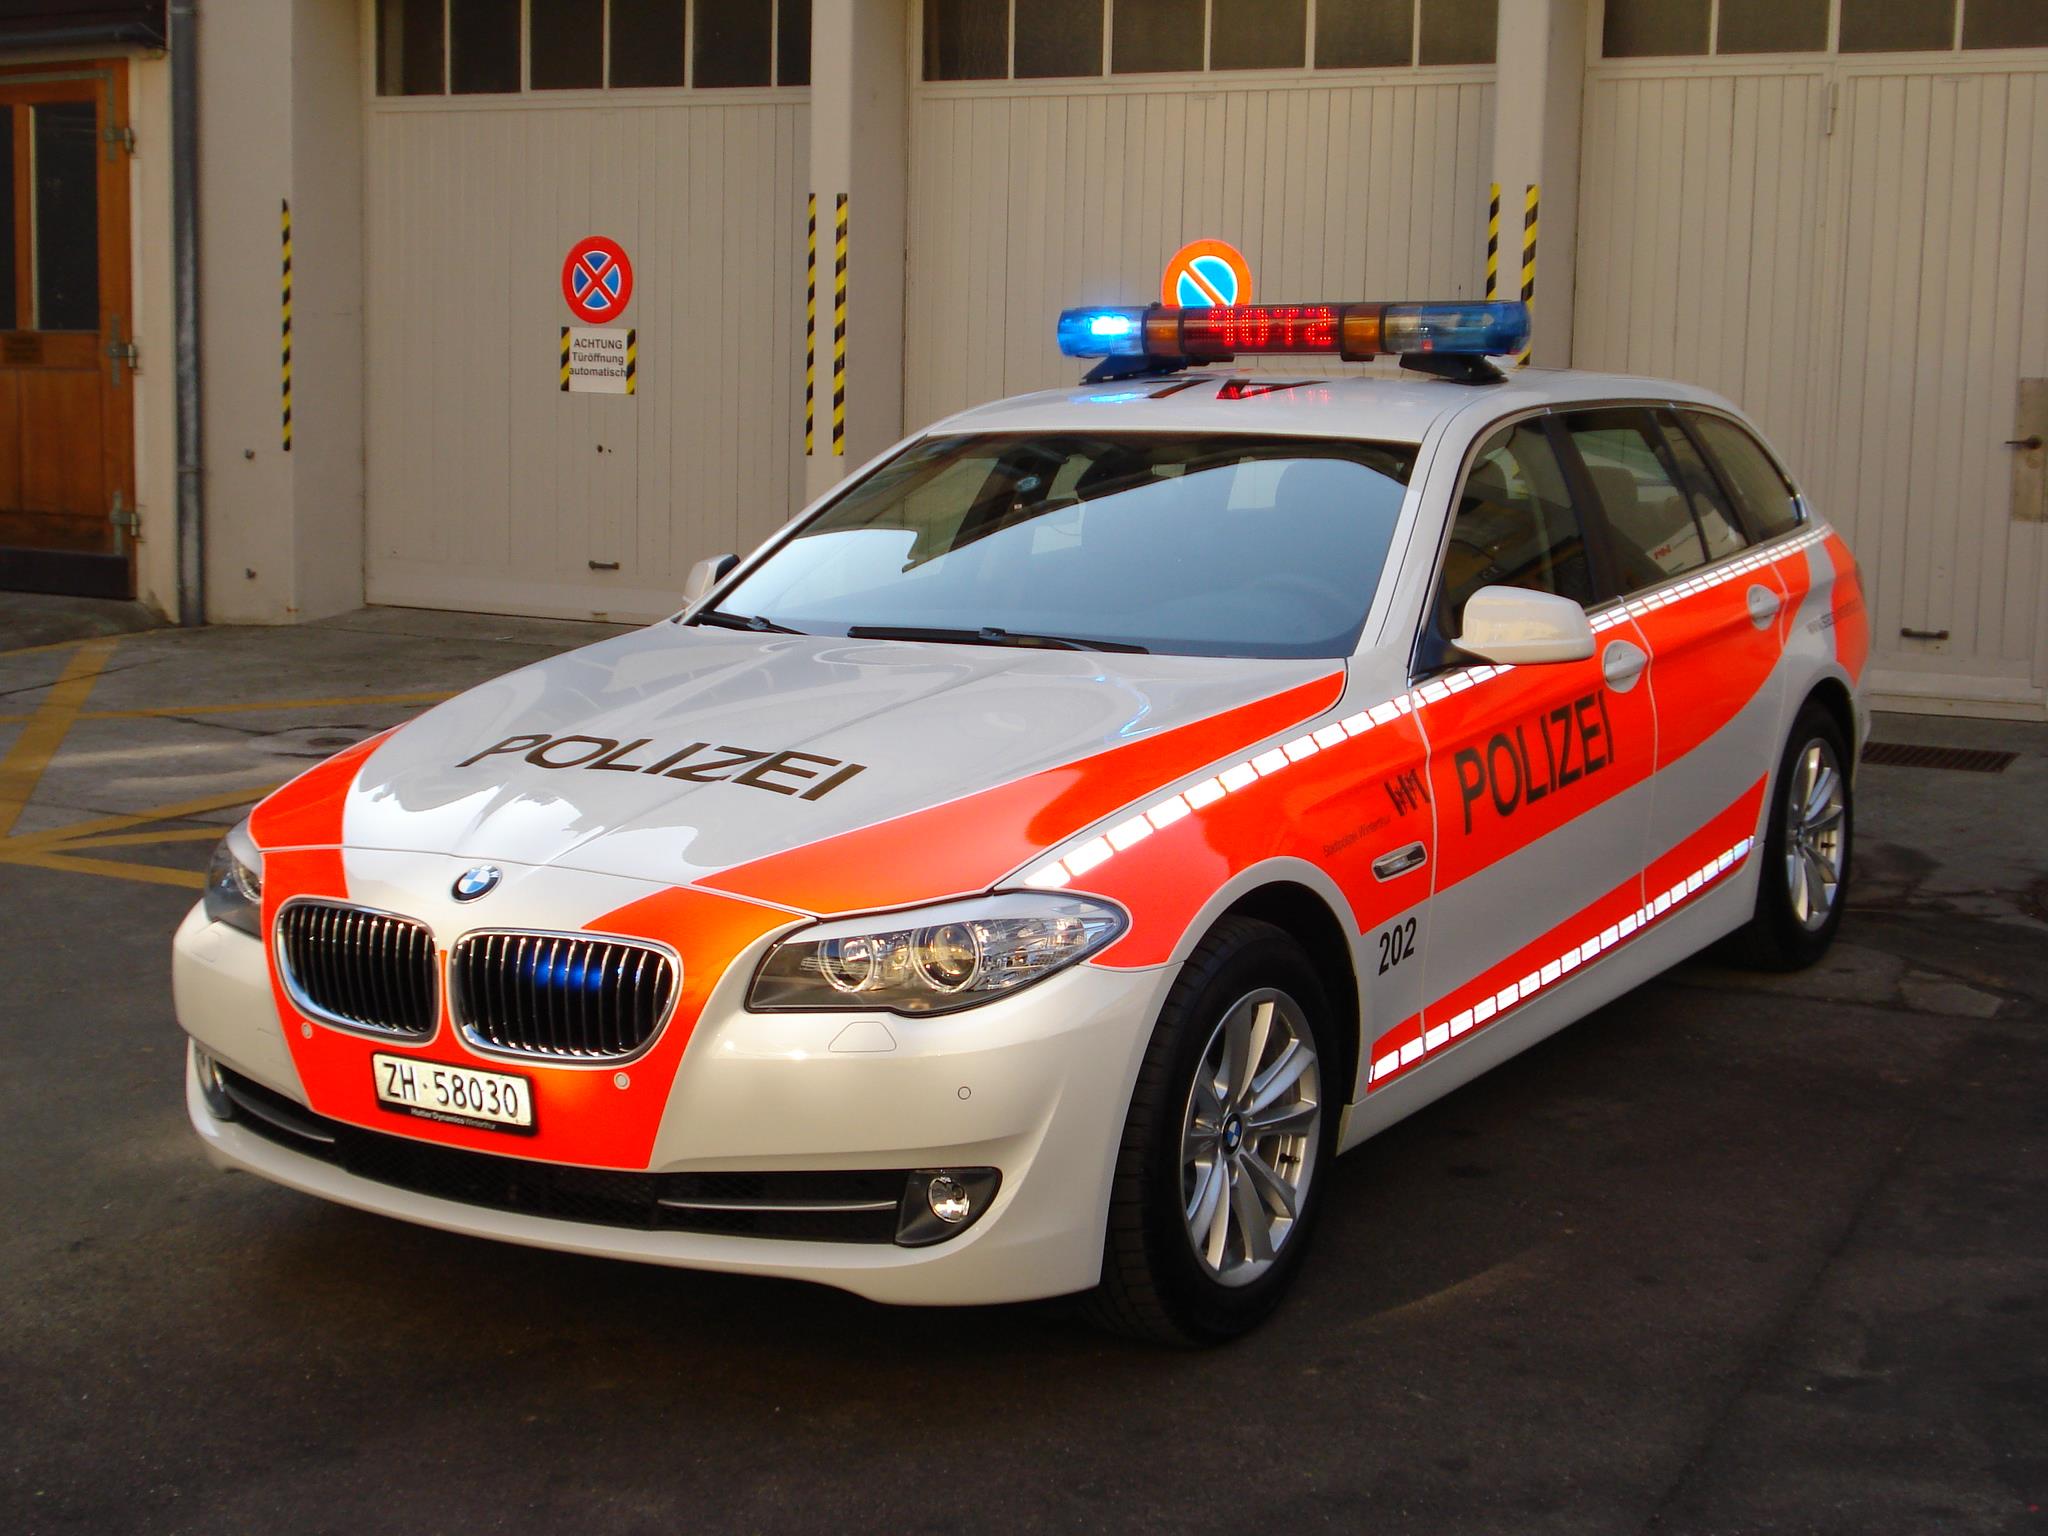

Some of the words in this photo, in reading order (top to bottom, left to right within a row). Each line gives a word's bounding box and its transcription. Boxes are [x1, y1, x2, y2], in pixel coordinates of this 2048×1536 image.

[568, 366, 627, 377] automatisch
[572, 351, 624, 366] Türöffnung
[574, 338, 623, 350] ACHTUNG
[455, 734, 868, 802] POLIZEI
[1454, 689, 1615, 836] POLIZEI
[1378, 916, 1417, 976] 202
[383, 1062, 417, 1102] ZH
[433, 1071, 518, 1118] 58030
